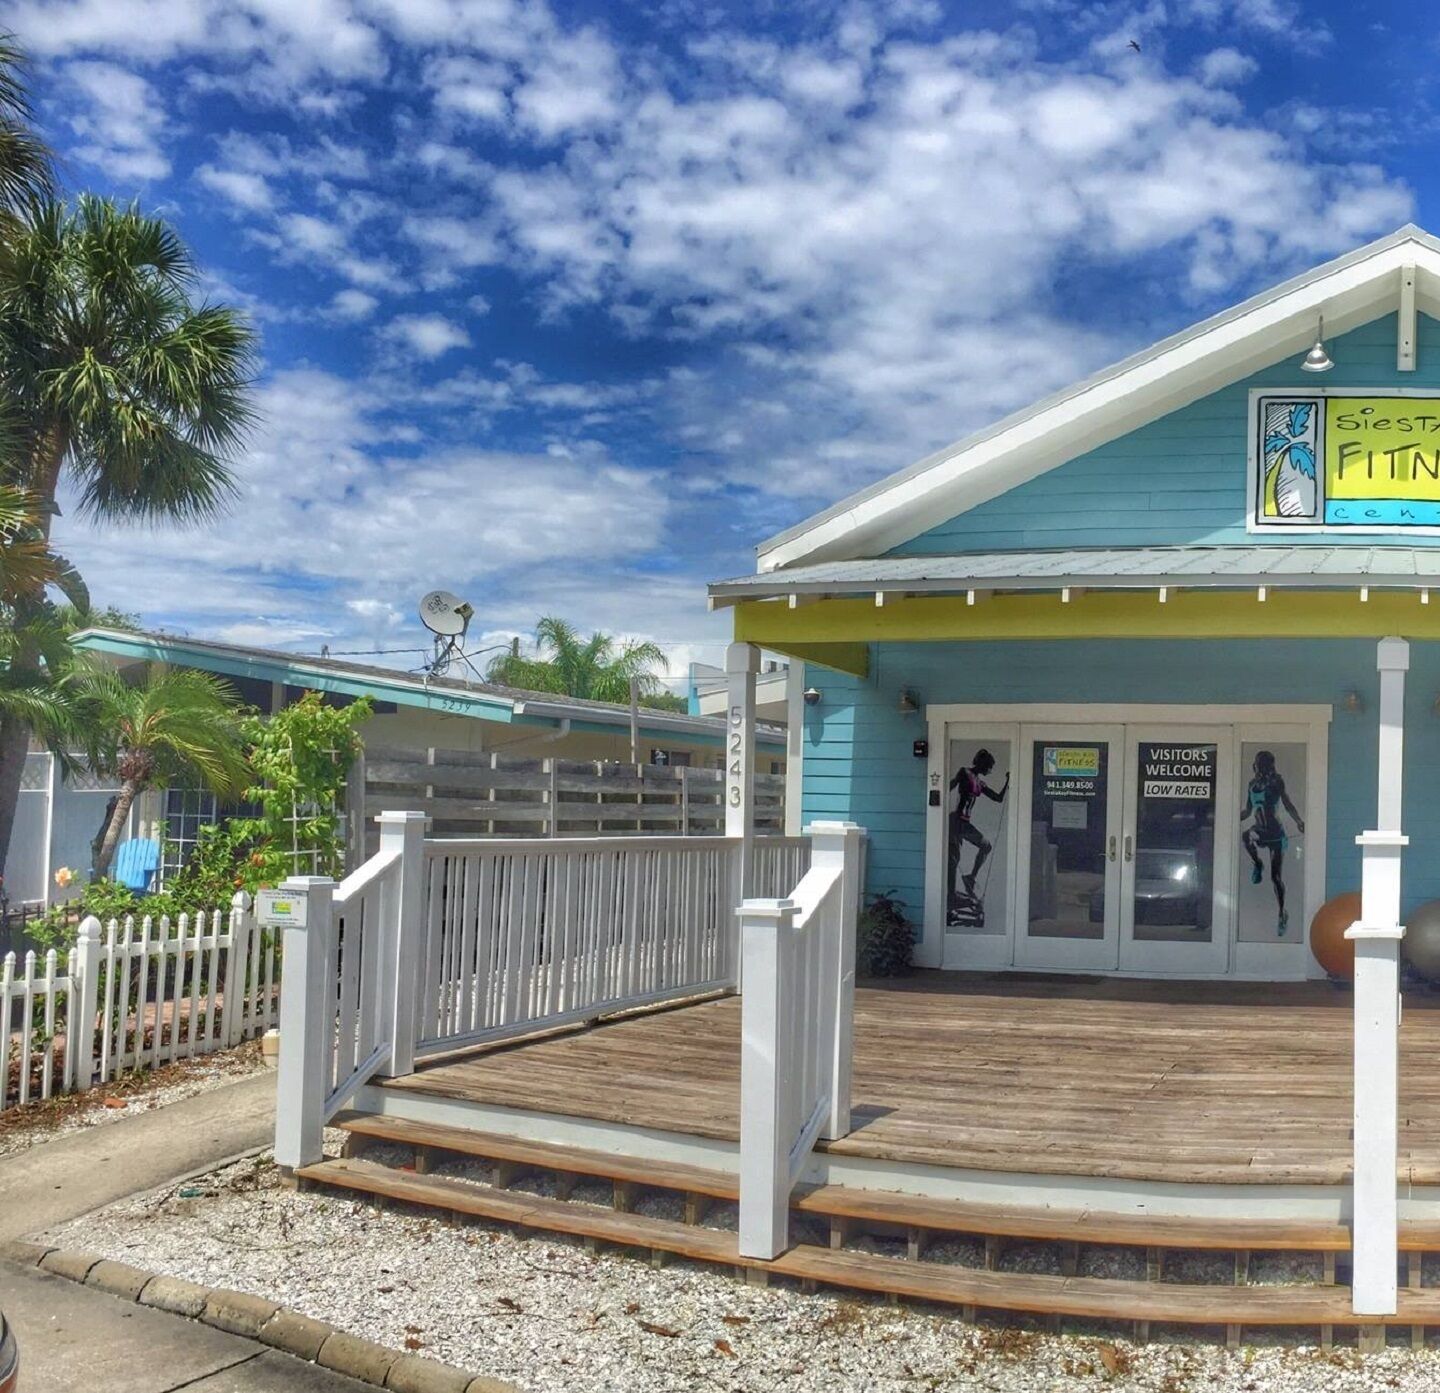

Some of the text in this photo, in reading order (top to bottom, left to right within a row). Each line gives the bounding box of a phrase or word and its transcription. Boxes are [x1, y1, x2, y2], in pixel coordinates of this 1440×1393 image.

[441, 699, 471, 713] 5239
[729, 705, 743, 809] 5243
[1150, 748, 1208, 761] VISITORS
[1058, 757, 1096, 767] FITNESS
[1145, 764, 1212, 777] WELCOME
[1146, 784, 1208, 797] LOW RATES
